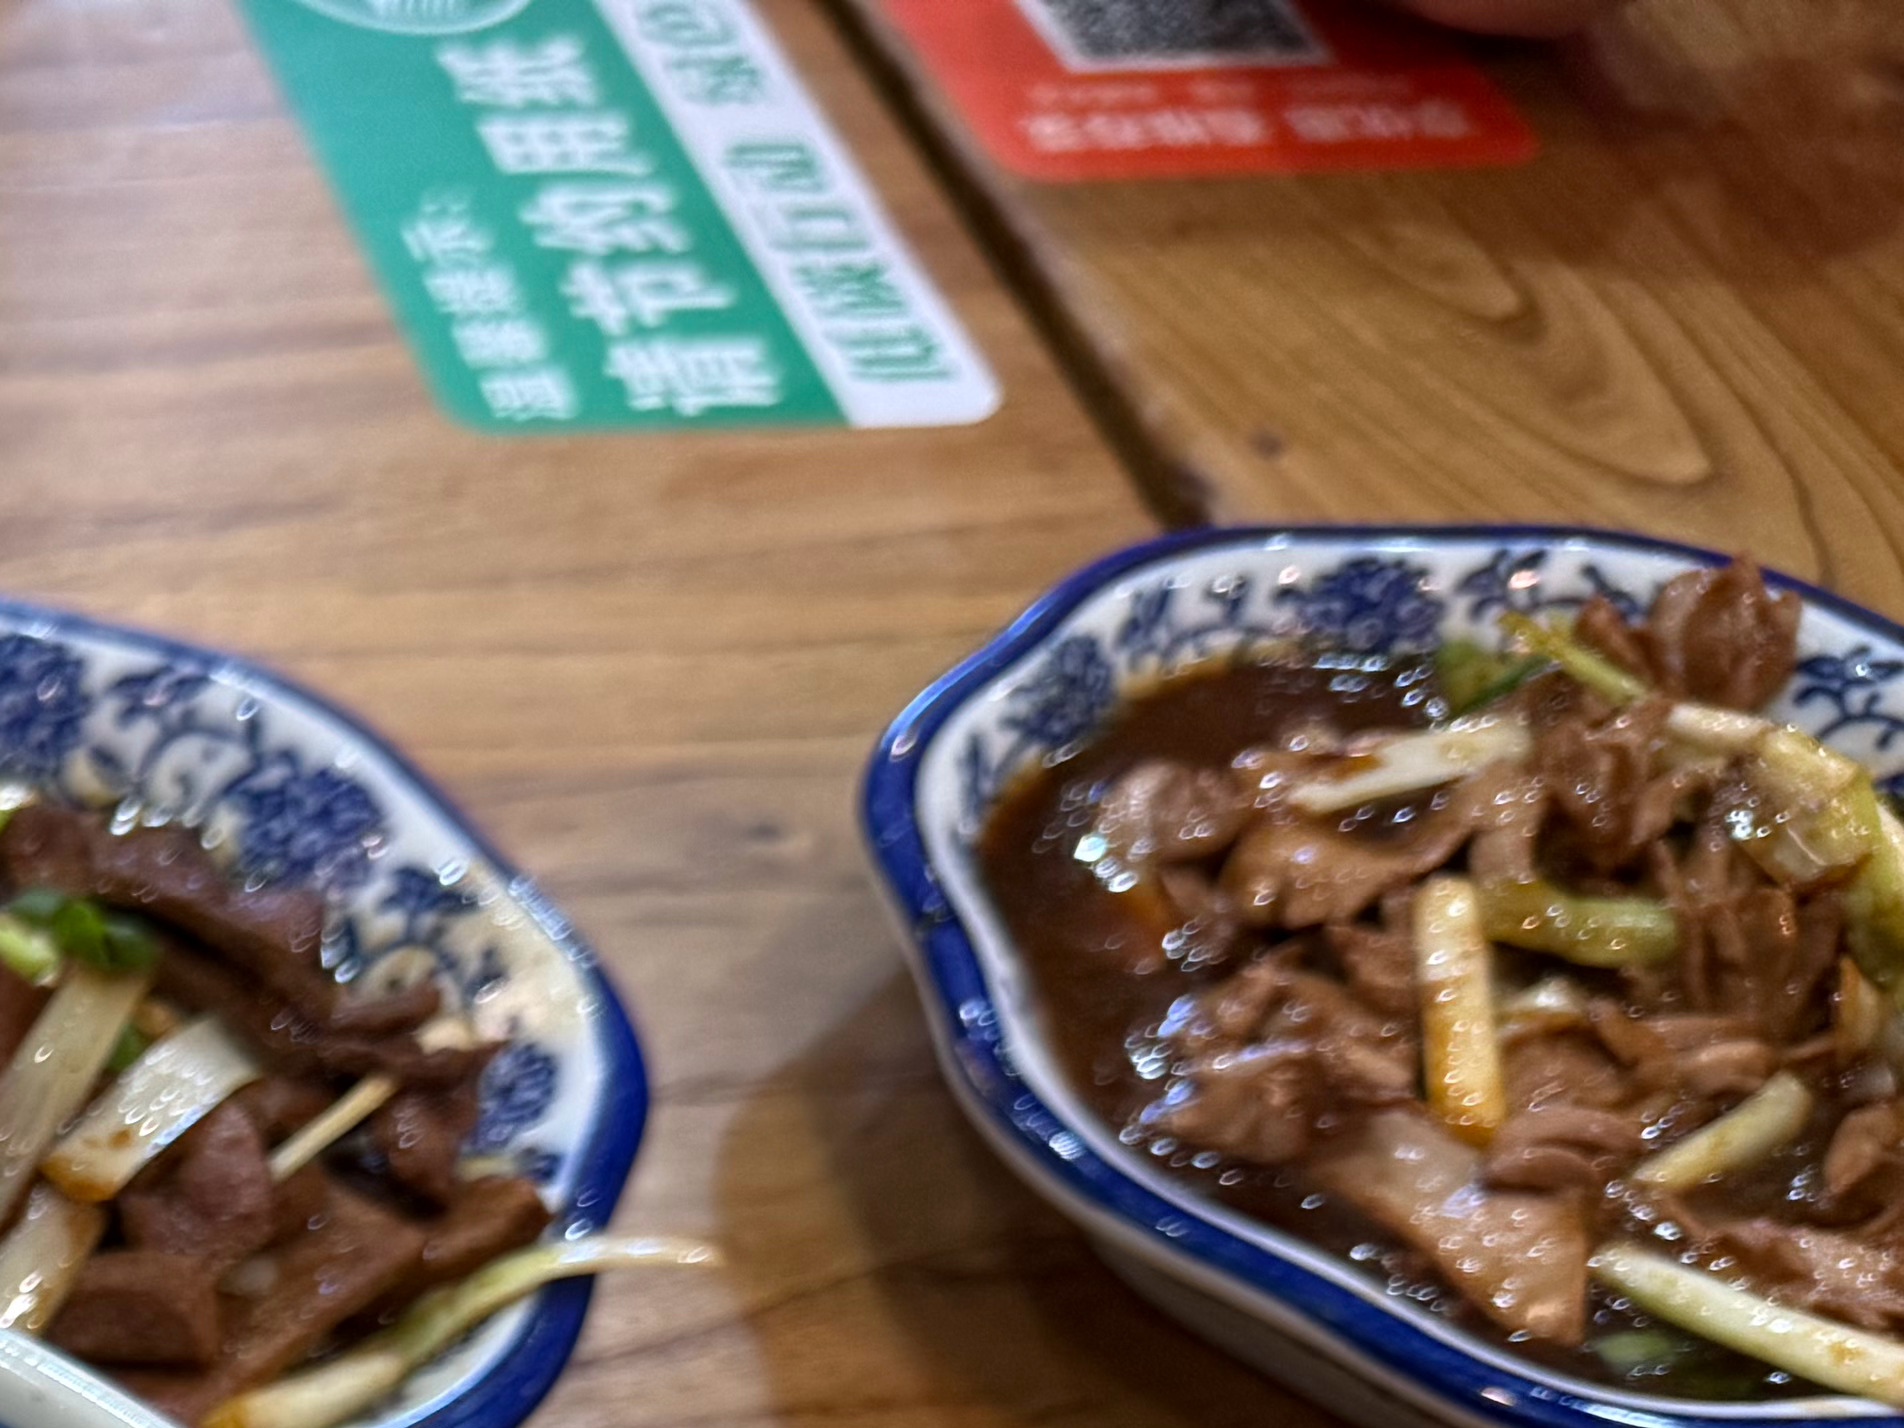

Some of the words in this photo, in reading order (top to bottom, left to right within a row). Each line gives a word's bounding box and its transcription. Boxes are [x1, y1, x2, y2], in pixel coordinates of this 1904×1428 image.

[435, 33, 782, 415] 请节约用纸
